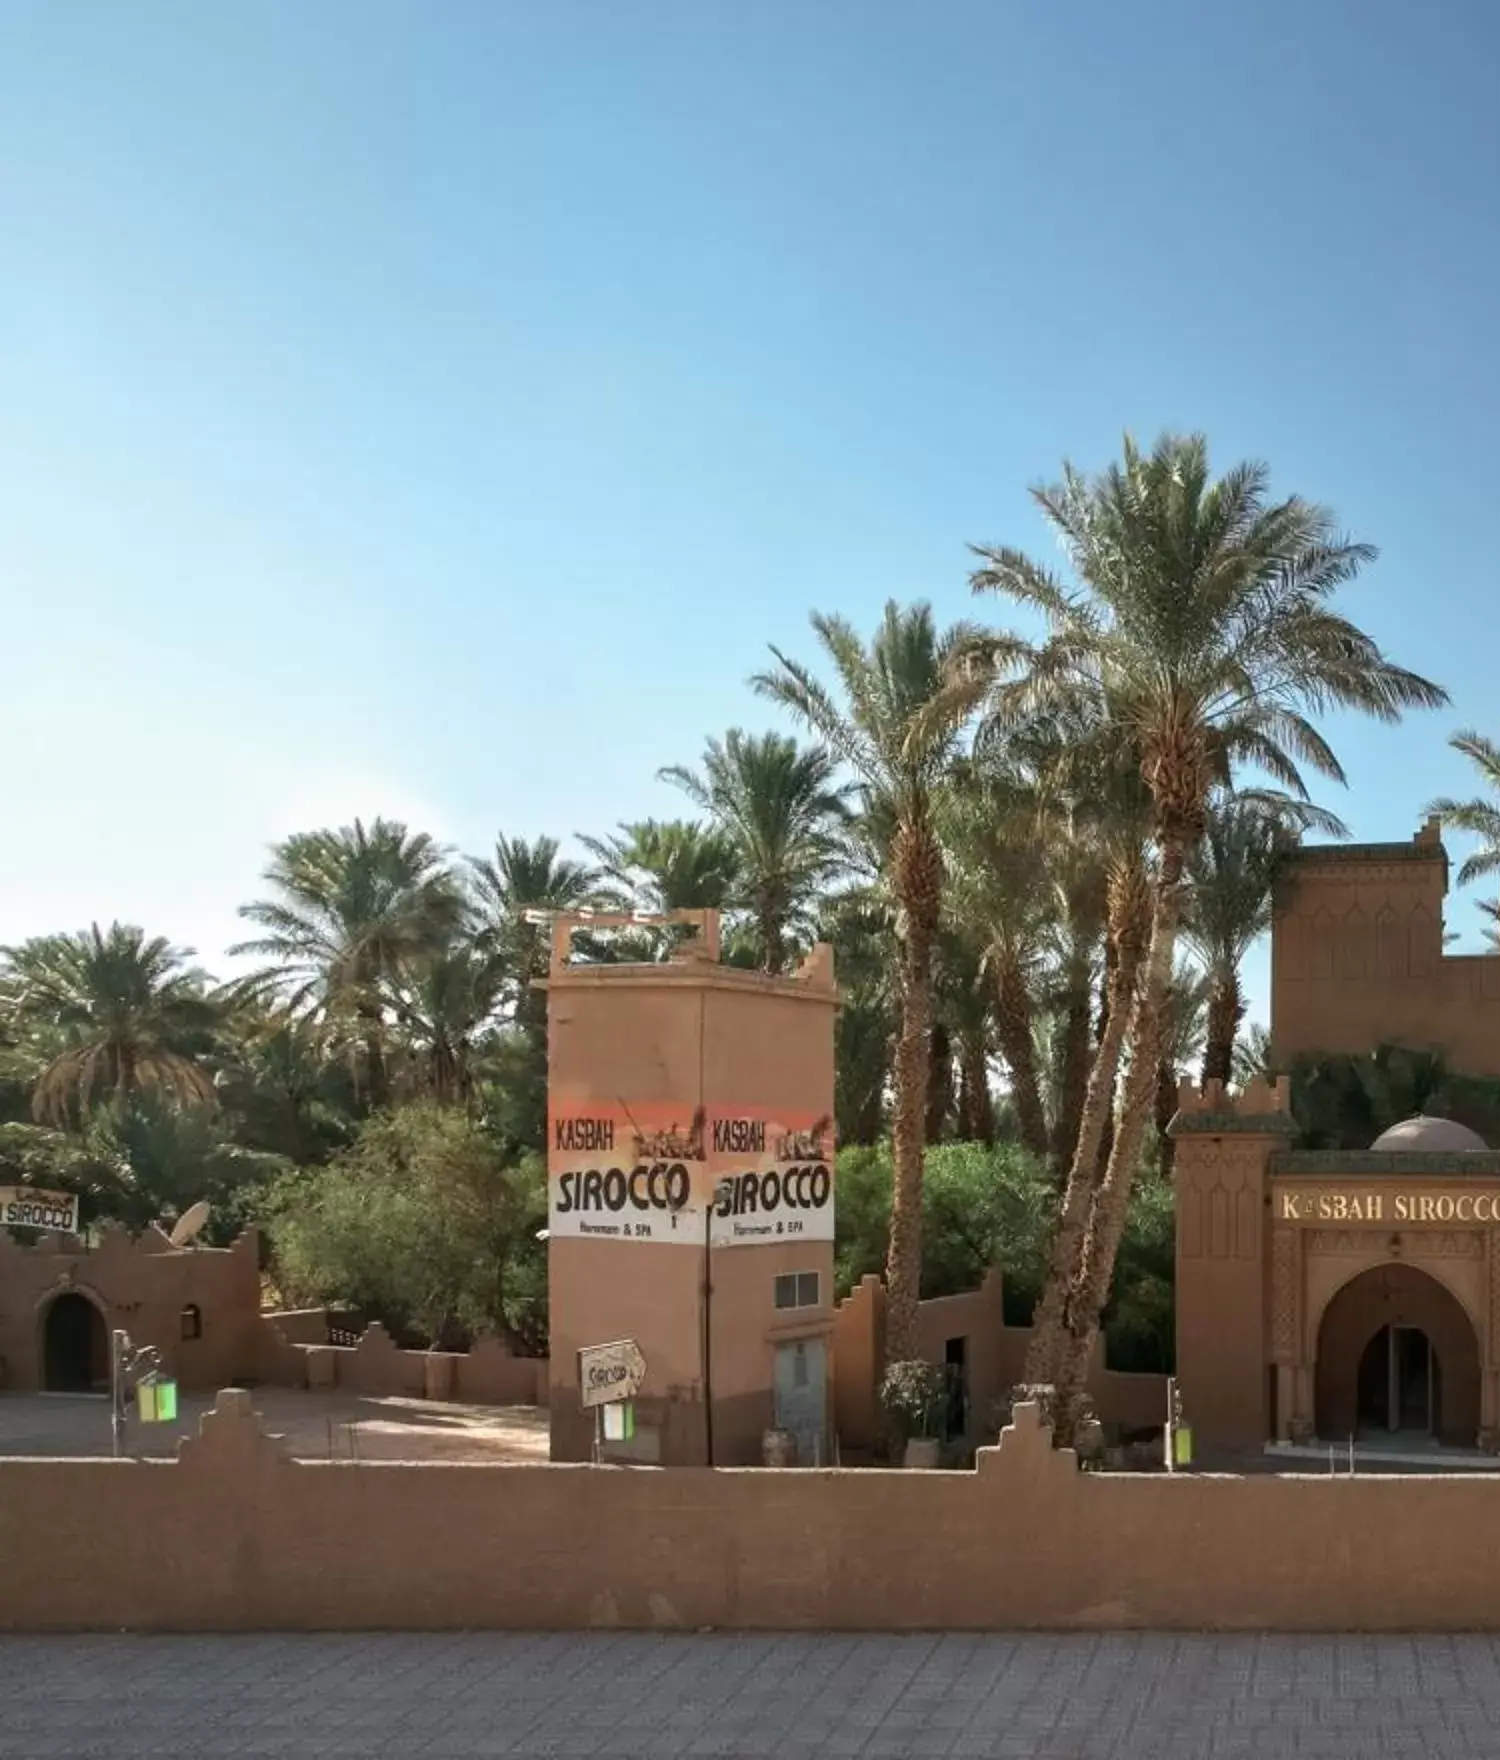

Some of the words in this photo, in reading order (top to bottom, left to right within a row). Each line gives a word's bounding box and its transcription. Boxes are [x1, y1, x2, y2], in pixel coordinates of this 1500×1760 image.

[556, 1120, 613, 1150] KASBAH
[713, 1120, 764, 1152] KASBAH
[557, 1163, 690, 1212] SIROCCO
[717, 1165, 830, 1217] SIROCCO
[8, 1202, 72, 1228] SIROCCO
